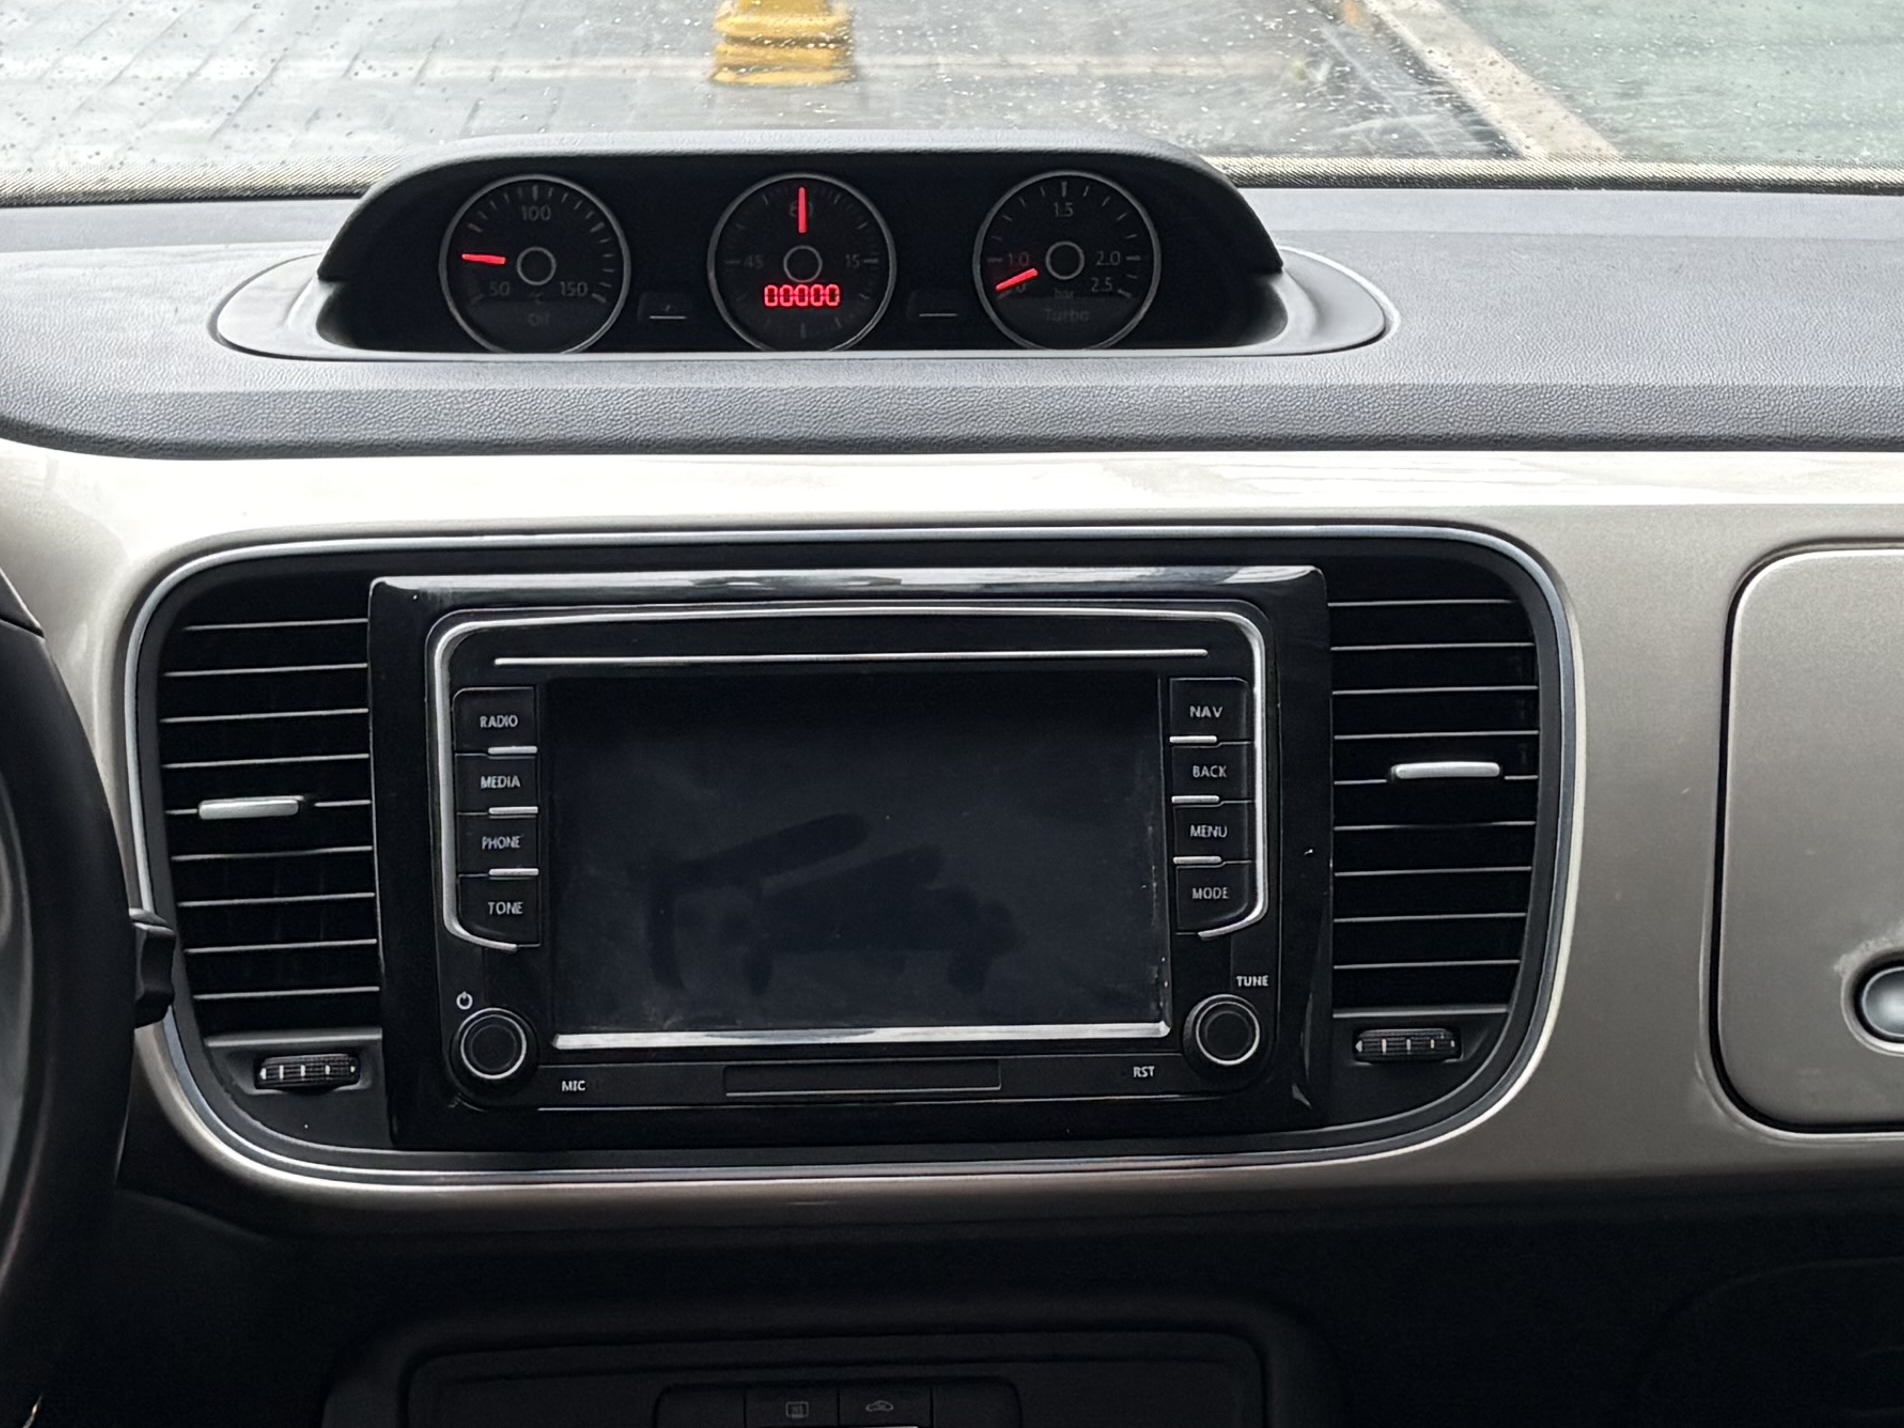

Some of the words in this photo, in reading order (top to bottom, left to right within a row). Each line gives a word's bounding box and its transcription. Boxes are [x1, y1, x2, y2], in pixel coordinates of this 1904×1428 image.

[520, 205, 552, 221] 100
[742, 254, 765, 269] 45
[844, 254, 861, 269] 15
[1095, 250, 1122, 267] 2.0
[488, 281, 511, 297] 50
[560, 281, 589, 298] 150
[1090, 276, 1114, 293] 2.5
[528, 312, 551, 326] Oil
[1043, 307, 1090, 322] Turbo
[1189, 704, 1224, 720] NAV
[479, 713, 519, 729] RADIO
[1192, 764, 1227, 779] BACK
[480, 774, 521, 789] MEDIA
[1189, 823, 1228, 838] MENU
[481, 835, 522, 850] PHONE
[1191, 885, 1229, 900] MODE
[487, 900, 524, 915] TONE
[1236, 974, 1270, 988] TUNE
[1132, 1064, 1156, 1079] RST
[560, 1078, 587, 1093] MIC
